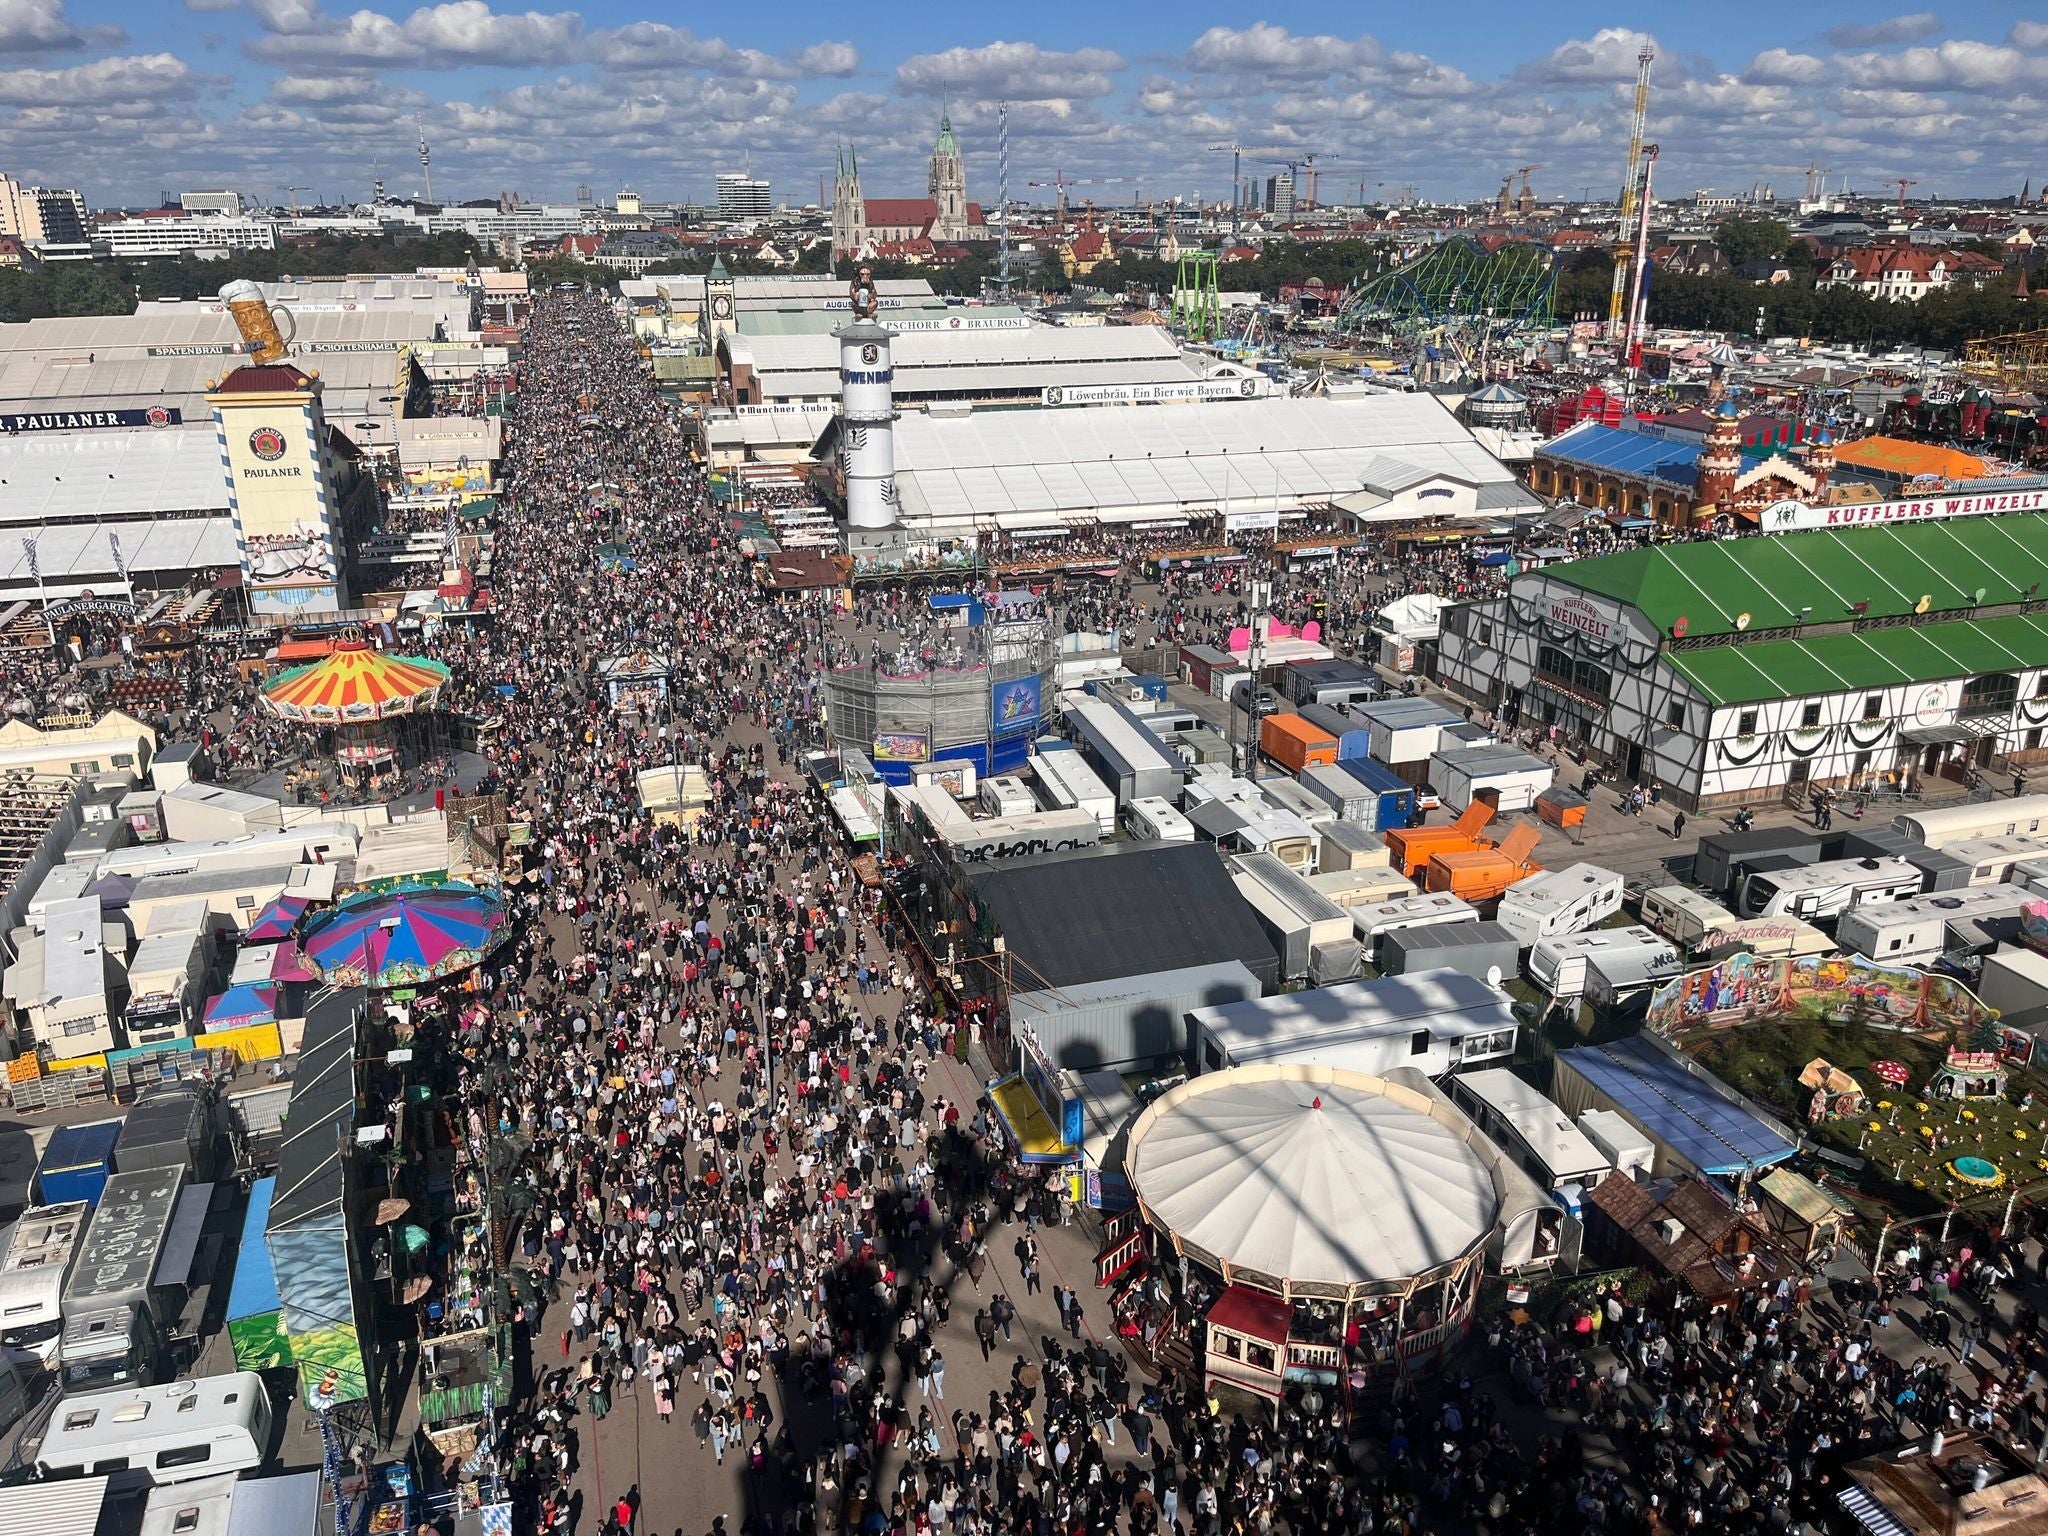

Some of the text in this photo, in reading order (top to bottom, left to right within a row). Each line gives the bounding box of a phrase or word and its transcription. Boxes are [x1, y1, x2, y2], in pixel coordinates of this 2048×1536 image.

[879, 298, 901, 307] BRÄU
[886, 317, 1026, 331] PSCHORR BRÄUROSL
[315, 342, 396, 352] SCHOTTENHAMEL
[1068, 384, 1235, 401] Löwenbräu. Ein Bier wie Bayern.
[747, 404, 828, 414] Münchner Stubn
[15, 411, 126, 430] PAULANER.
[250, 428, 283, 442] PAULANER
[1637, 421, 1666, 437] Rischart
[243, 466, 302, 478] PAULANER
[1827, 493, 2044, 525] KUFFLERS WEINZELT
[1235, 518, 1270, 529] Biergarten
[43, 601, 137, 620] PAULANERGARTEN
[1563, 600, 1598, 618] KUFFLERS
[1551, 604, 1610, 638] WEINZELT
